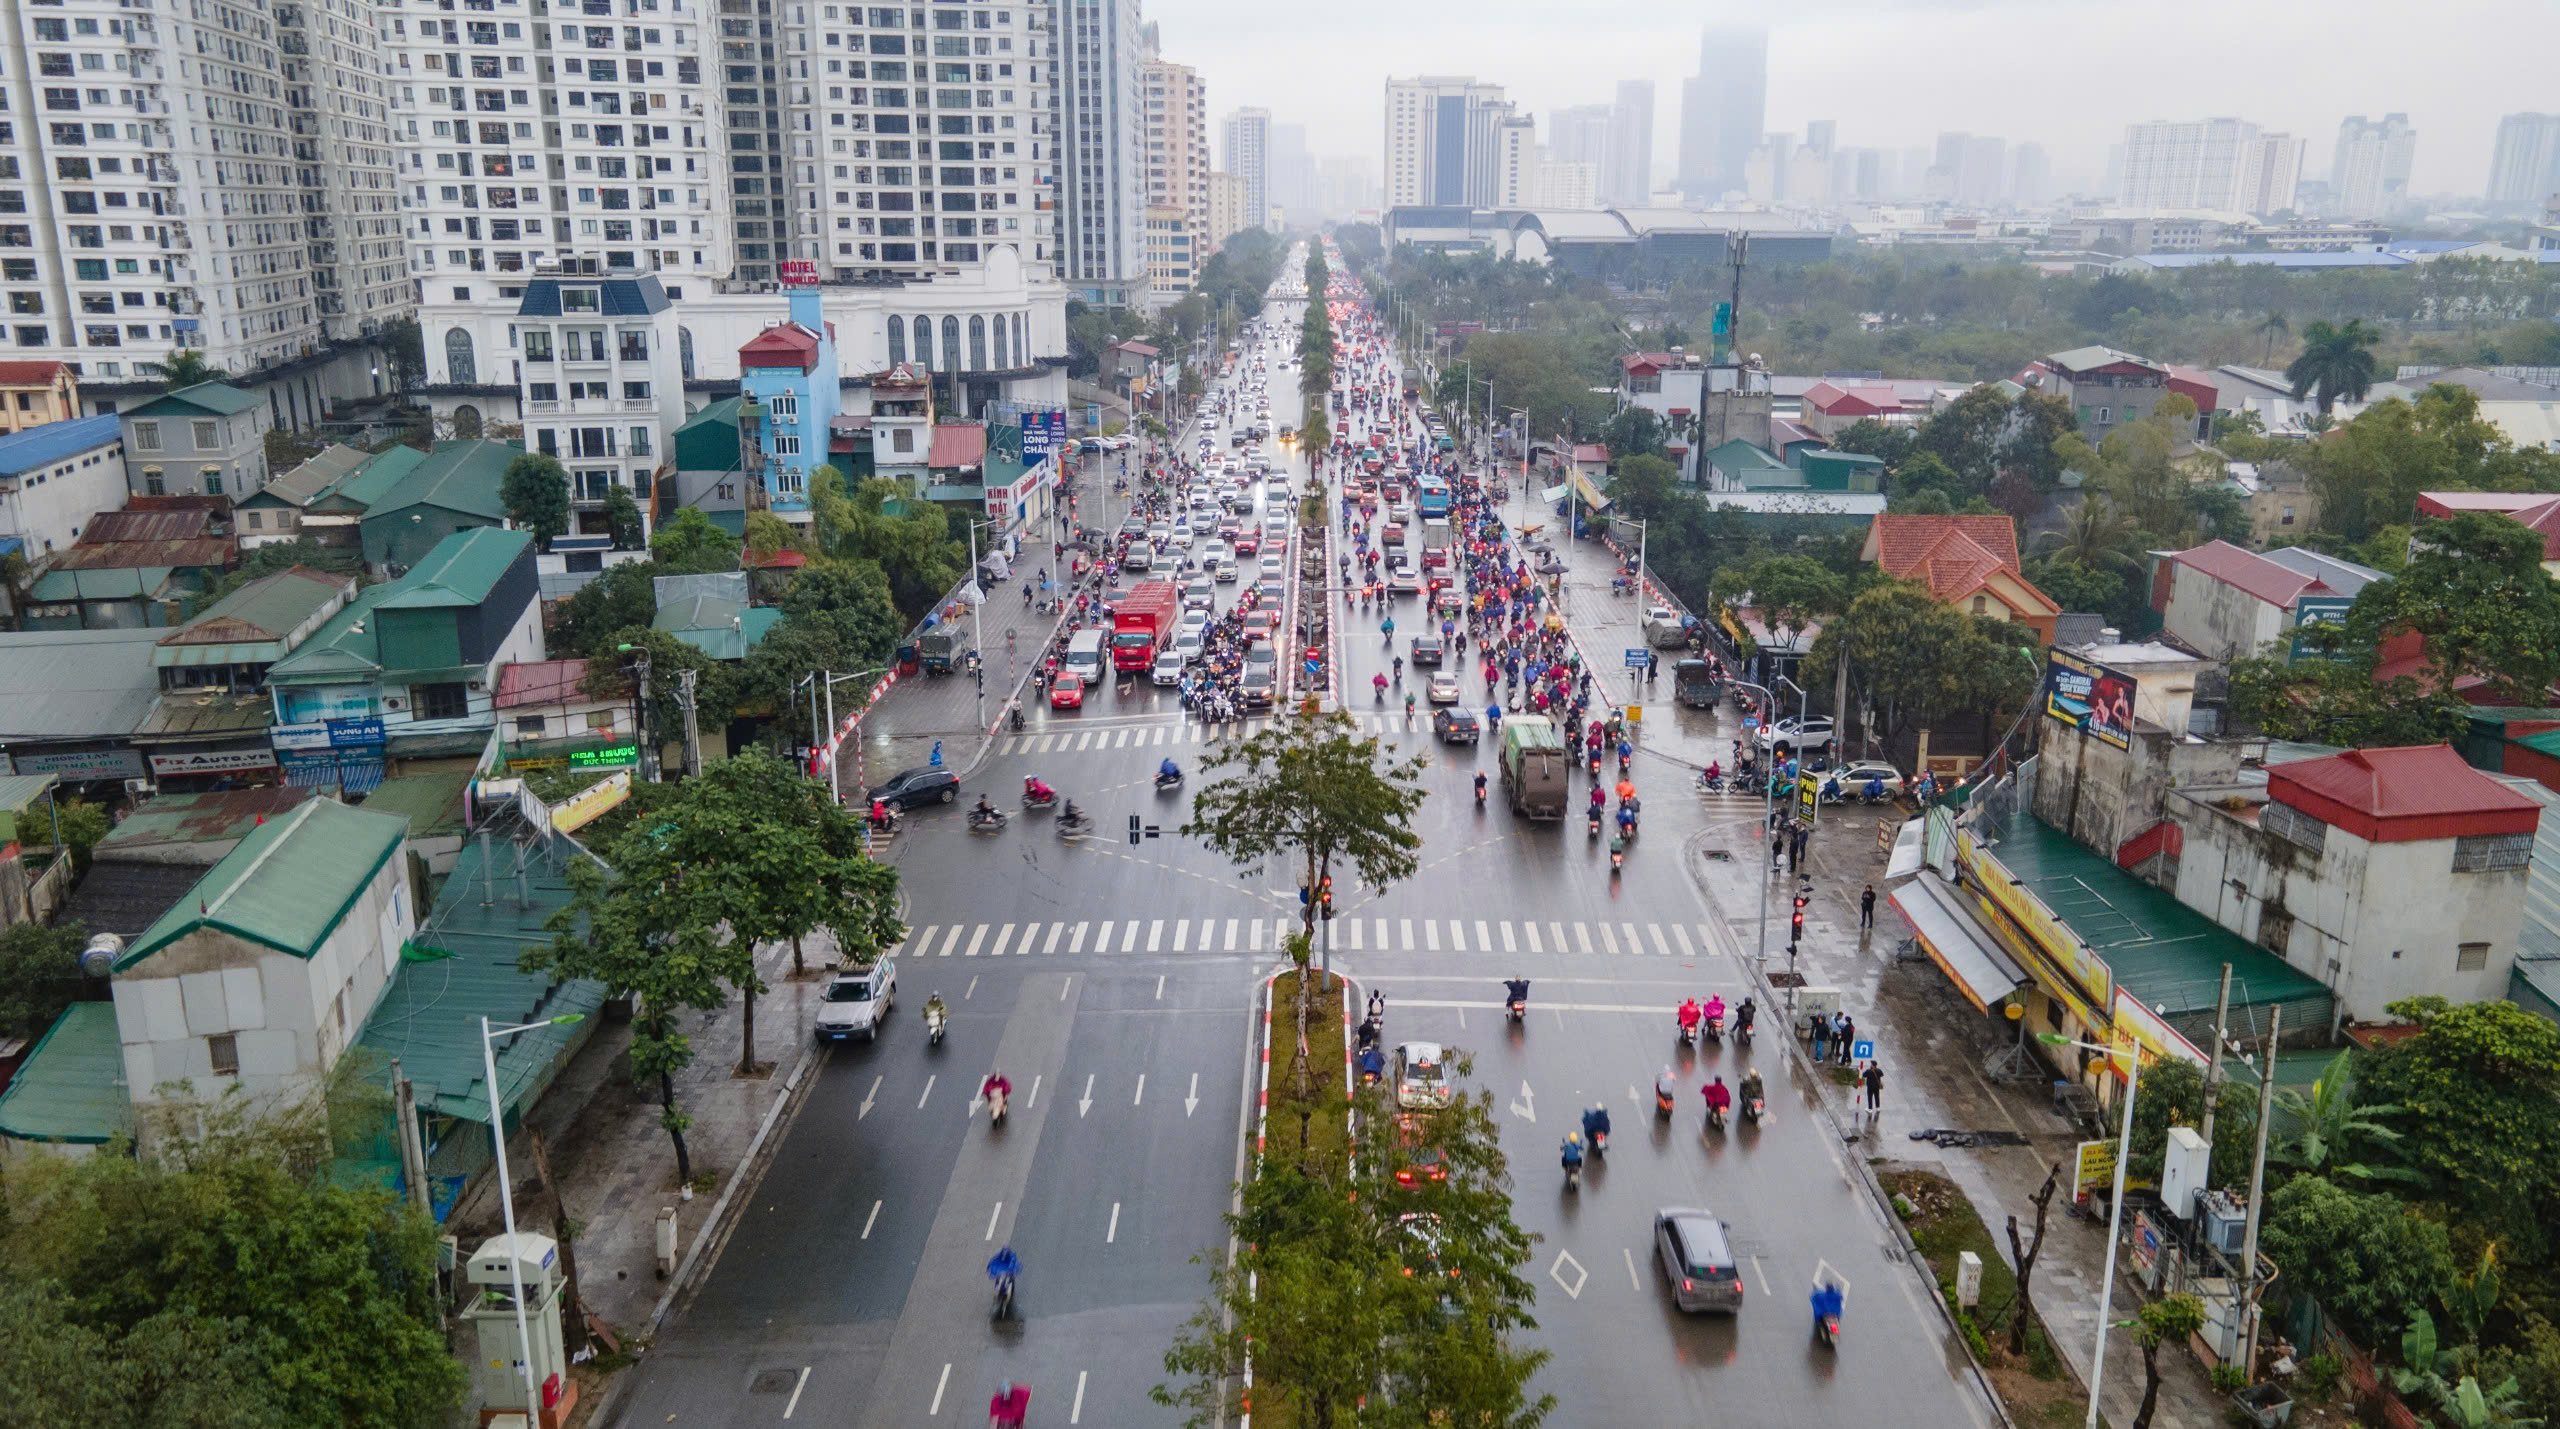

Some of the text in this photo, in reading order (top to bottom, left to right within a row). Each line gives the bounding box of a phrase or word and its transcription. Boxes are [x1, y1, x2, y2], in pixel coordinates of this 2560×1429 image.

[781, 261, 816, 273] HOTEL
[1023, 436, 1049, 444] LONG
[1023, 445, 1049, 454] CHÂU
[987, 486, 1008, 499] KÍNH
[364, 726, 380, 734] AN
[45, 754, 84, 763] PHONG
